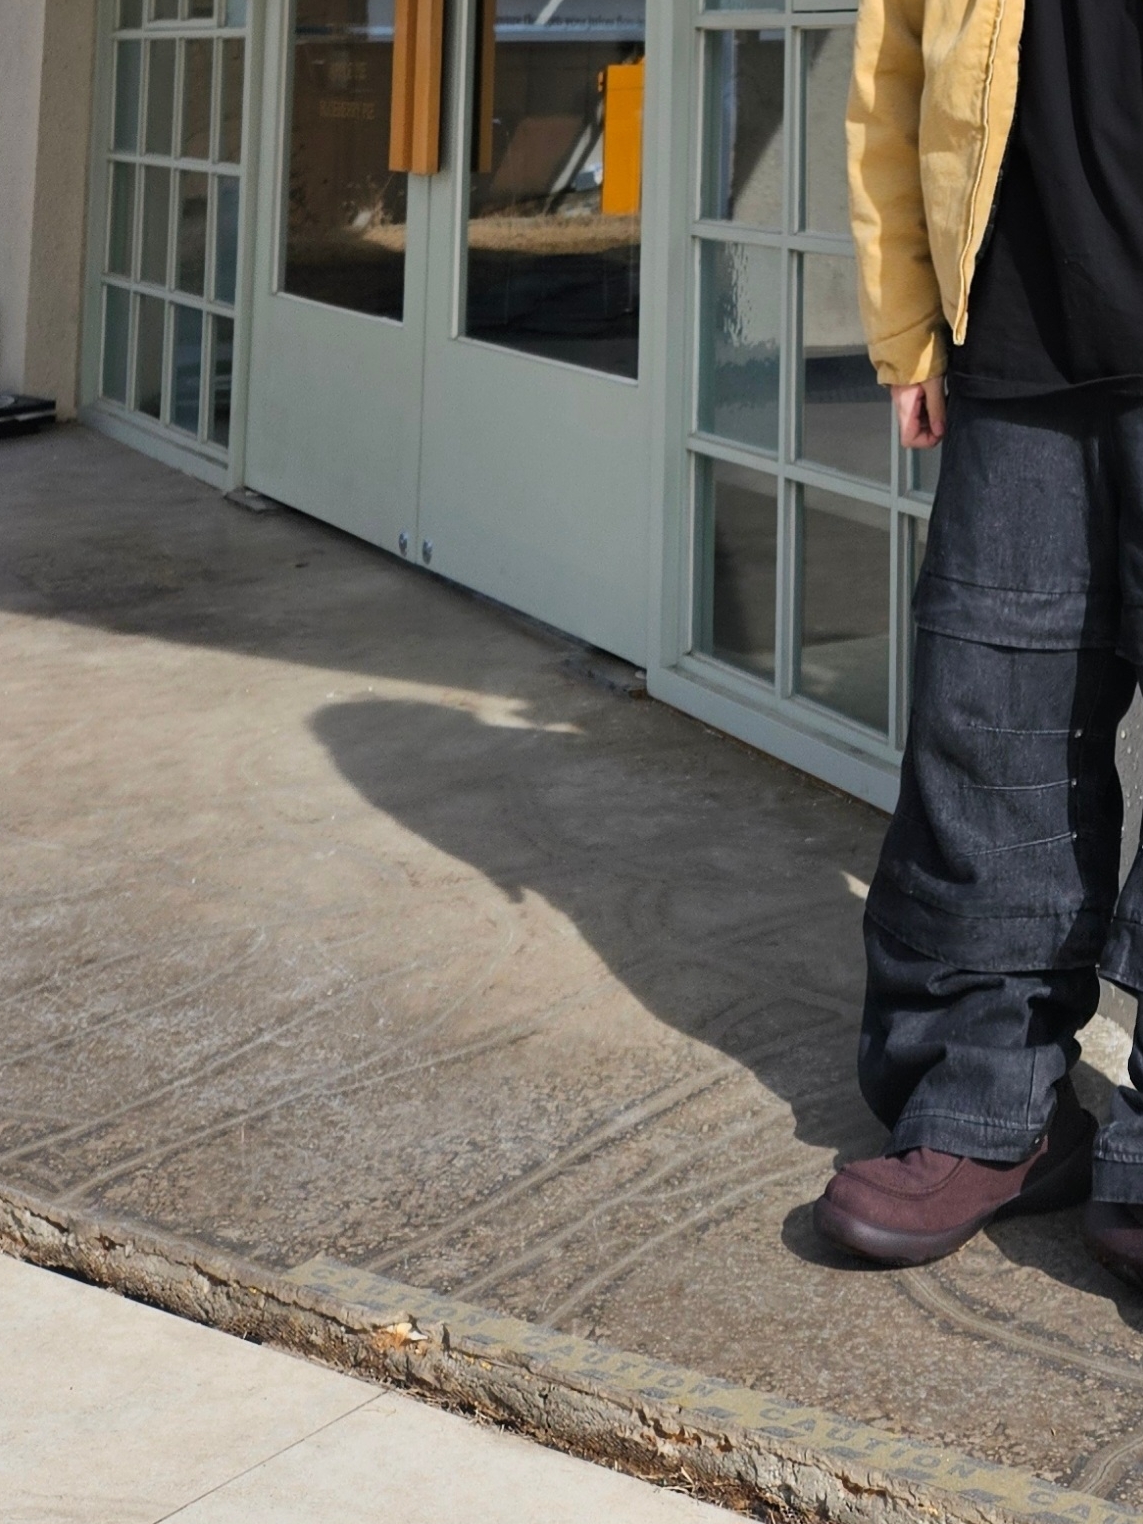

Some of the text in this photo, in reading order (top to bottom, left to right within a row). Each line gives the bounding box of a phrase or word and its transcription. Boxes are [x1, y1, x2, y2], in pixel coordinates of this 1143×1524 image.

[311, 1266, 485, 1327] CAUTION
[522, 1335, 715, 1398] CAUTION
[759, 1406, 977, 1477] CAUTION
